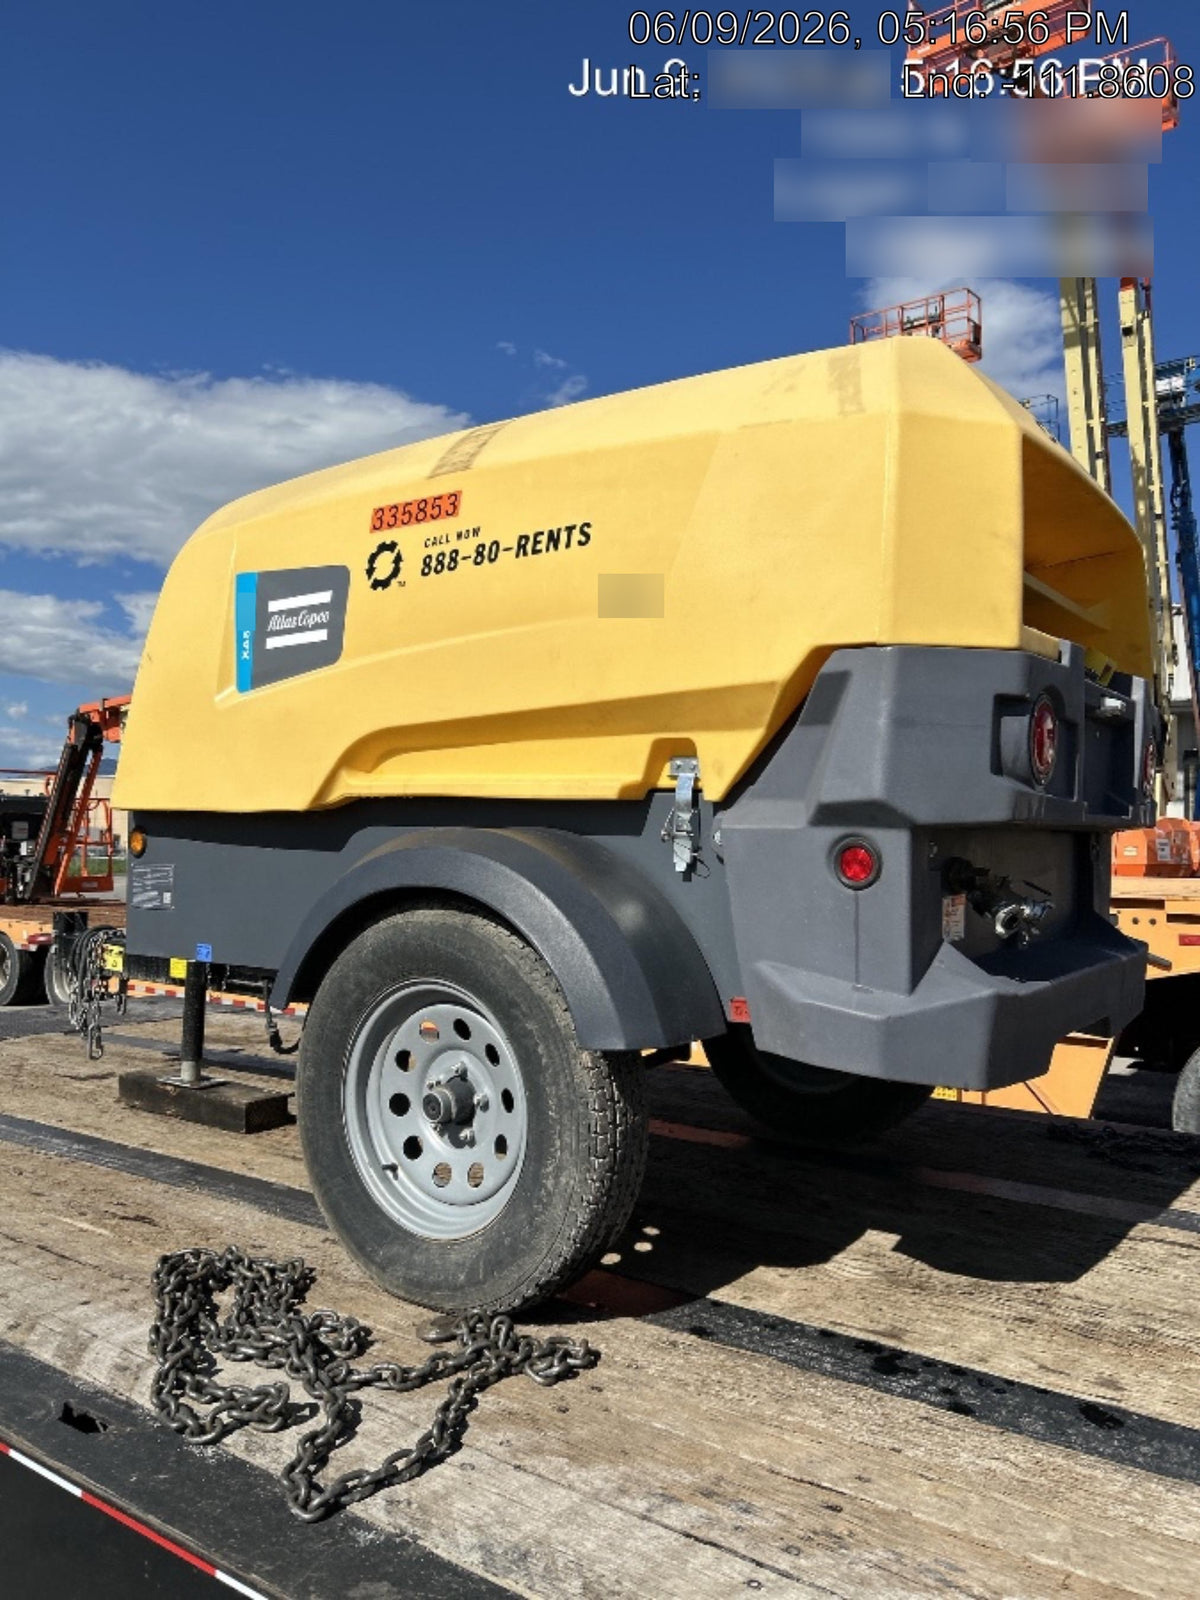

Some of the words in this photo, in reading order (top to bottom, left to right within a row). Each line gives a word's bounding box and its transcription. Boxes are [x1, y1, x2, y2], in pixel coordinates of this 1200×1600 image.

[372, 492, 459, 531] 335853
[420, 522, 593, 577] 888-80-RENTS
[424, 533, 451, 548] CALL
[456, 526, 481, 541] NOW
[267, 614, 297, 631] Atlas
[298, 609, 330, 628] Copco
